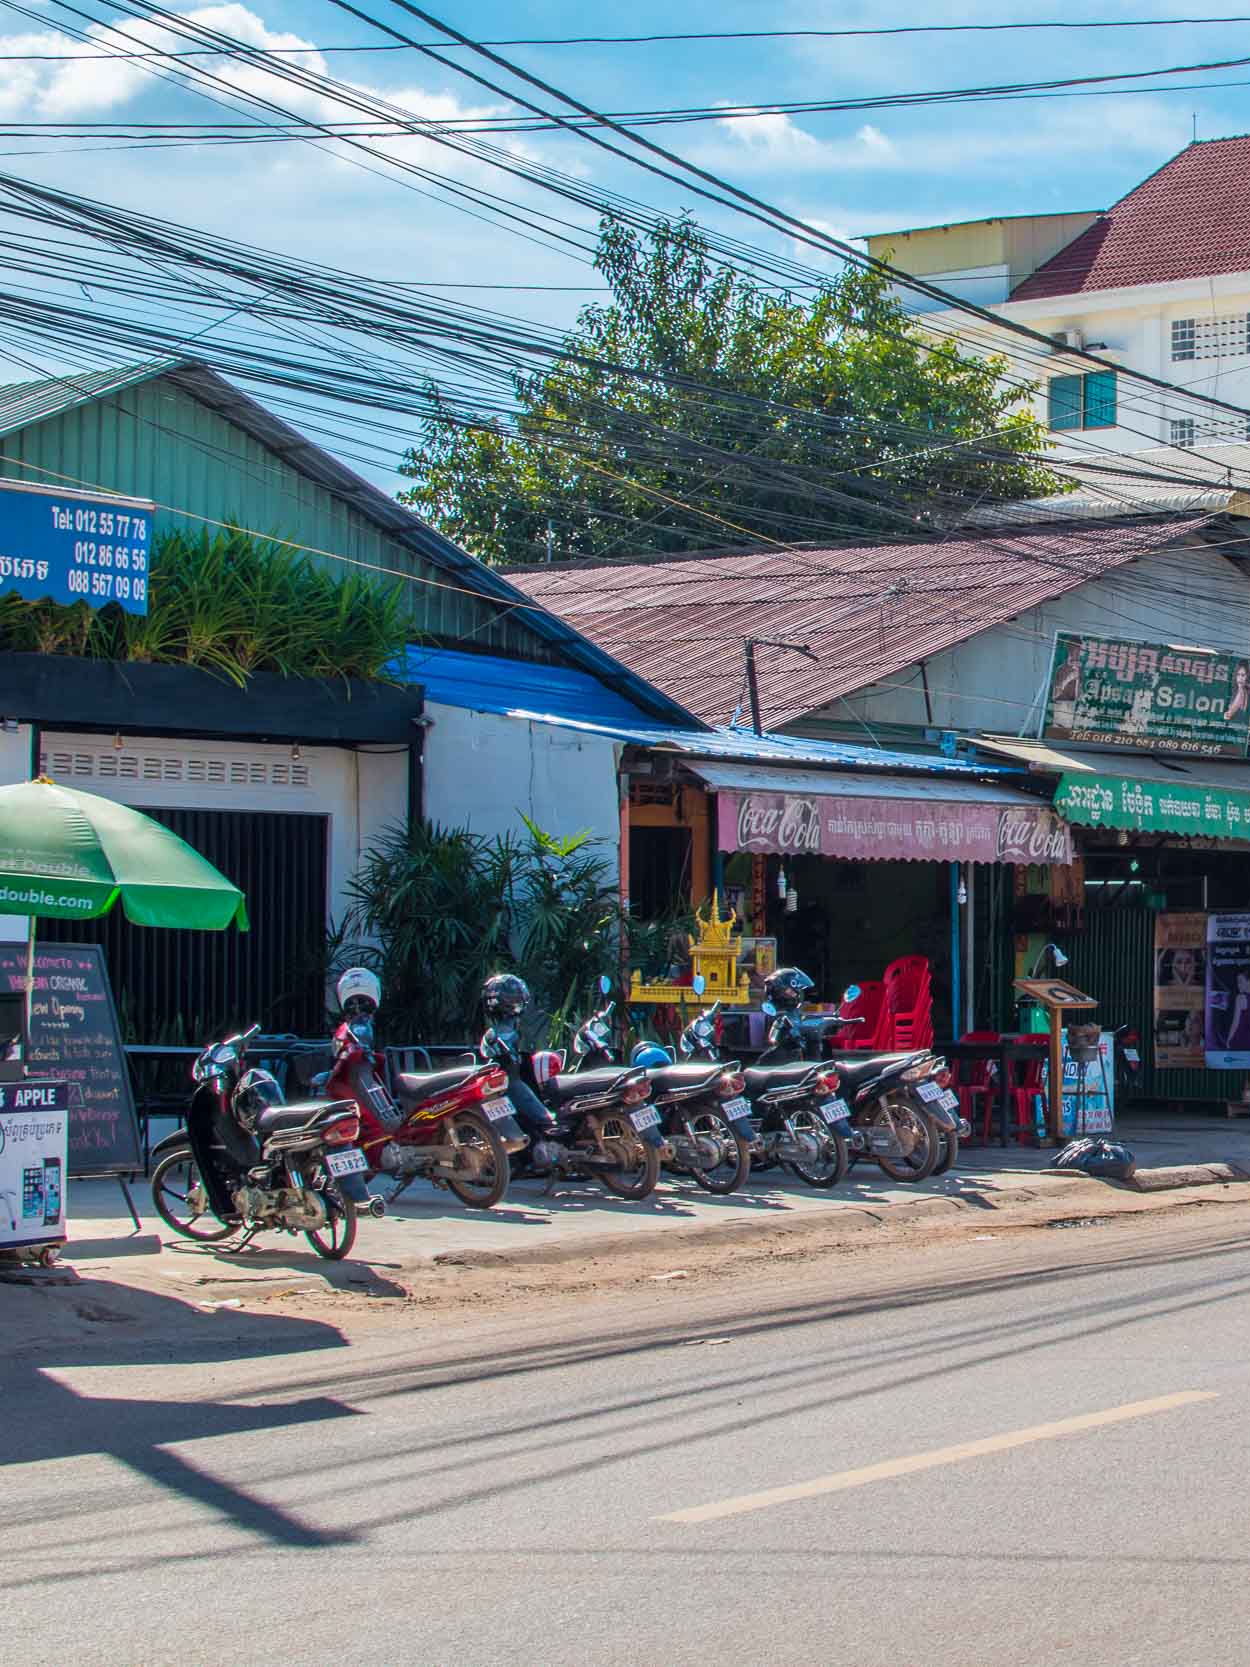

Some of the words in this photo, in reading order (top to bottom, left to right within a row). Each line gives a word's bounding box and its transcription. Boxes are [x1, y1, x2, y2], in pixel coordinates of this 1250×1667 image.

[51, 505, 74, 530] Tel:
[75, 509, 97, 533] 012
[99, 512, 114, 536] 55
[116, 514, 130, 538] 77
[131, 518, 146, 540] 78
[74, 541, 97, 565] 012
[98, 545, 113, 567] 86
[114, 546, 129, 569] 66
[131, 548, 146, 571] 56
[67, 569, 89, 593] 088
[92, 572, 113, 596] 567
[115, 575, 130, 599] 09
[132, 578, 146, 600] 09
[1156, 686, 1226, 713] Salon
[1092, 733, 1113, 744] 016
[1114, 735, 1134, 745] 210
[15, 1087, 56, 1107] APPLE
